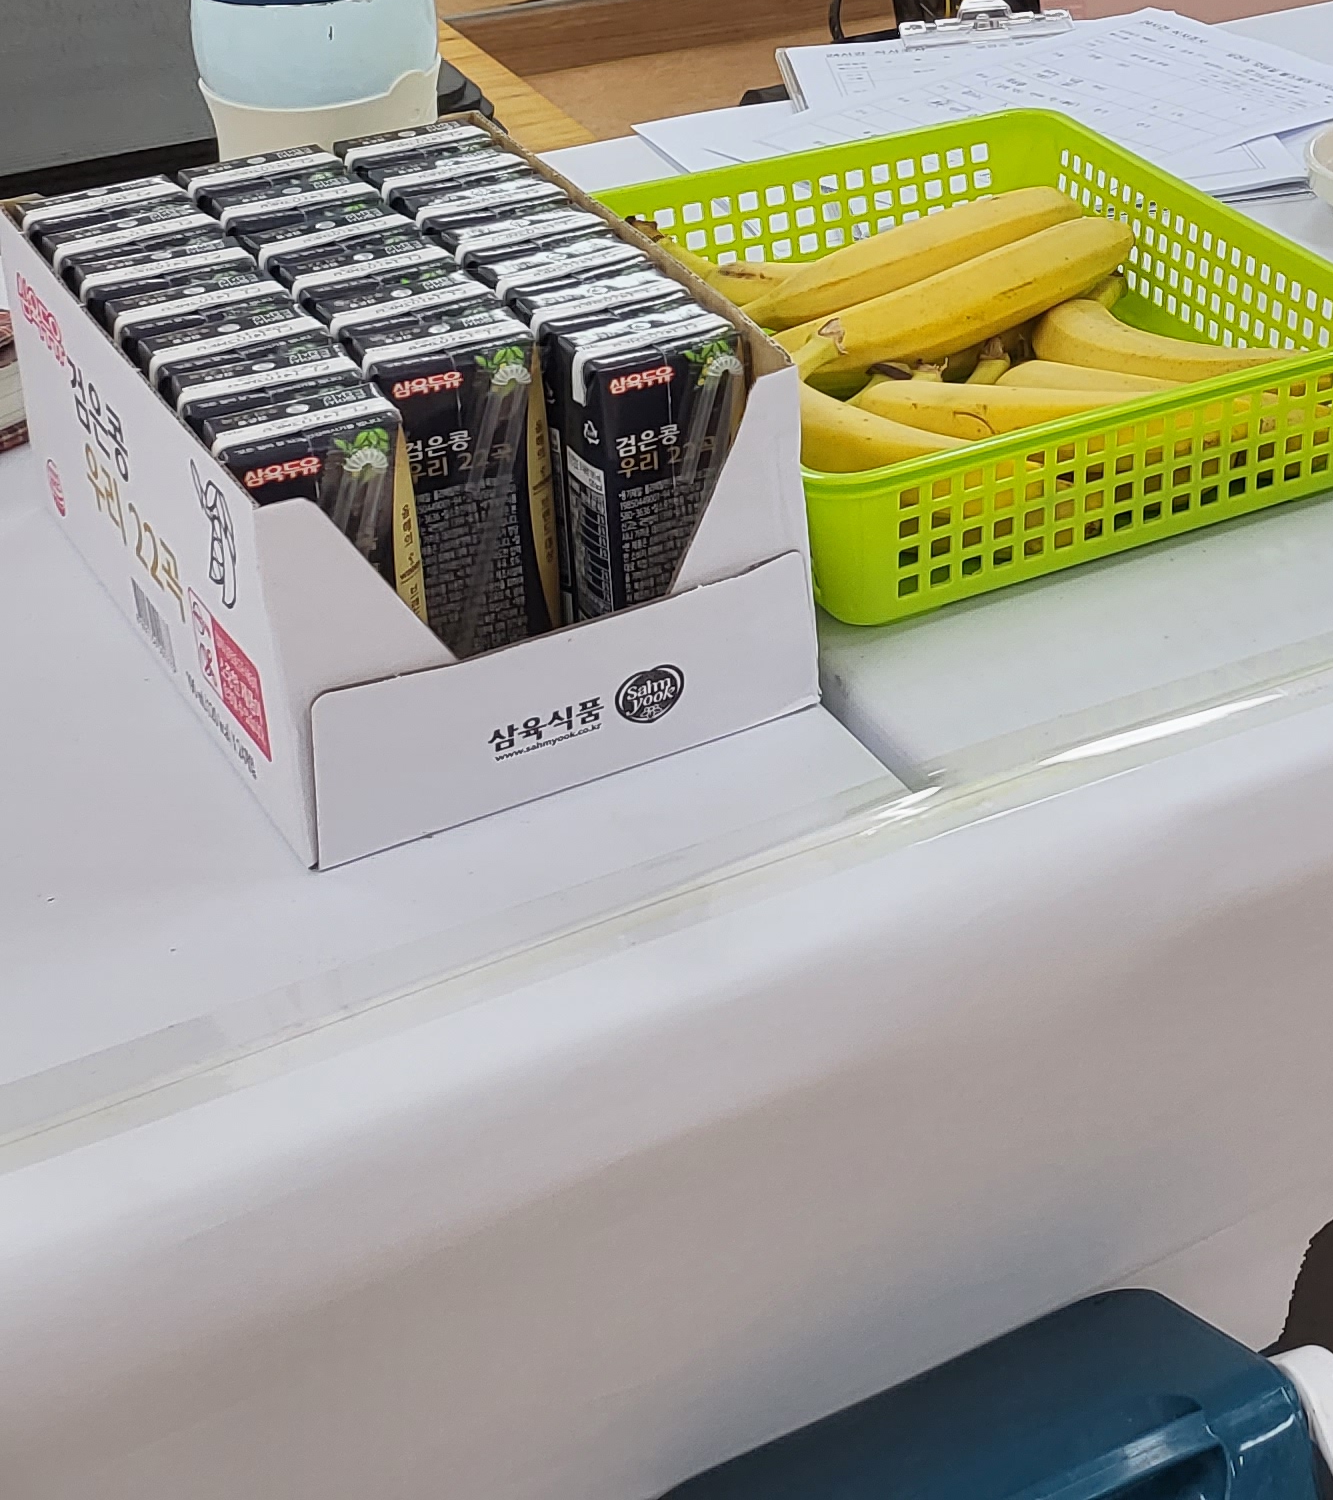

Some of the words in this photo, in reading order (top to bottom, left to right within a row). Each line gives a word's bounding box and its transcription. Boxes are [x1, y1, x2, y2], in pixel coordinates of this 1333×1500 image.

[391, 371, 464, 400] 삼육두유
[608, 365, 675, 396] 삼육두유
[66, 355, 130, 483] 검은콩
[615, 423, 681, 459] 검은콩
[243, 455, 322, 488] 삼육두유
[617, 451, 660, 479] 우리
[85, 442, 128, 547] 우리
[487, 696, 605, 753] 삼육식품
[494, 722, 602, 762] www.sahmyook.co.kr
